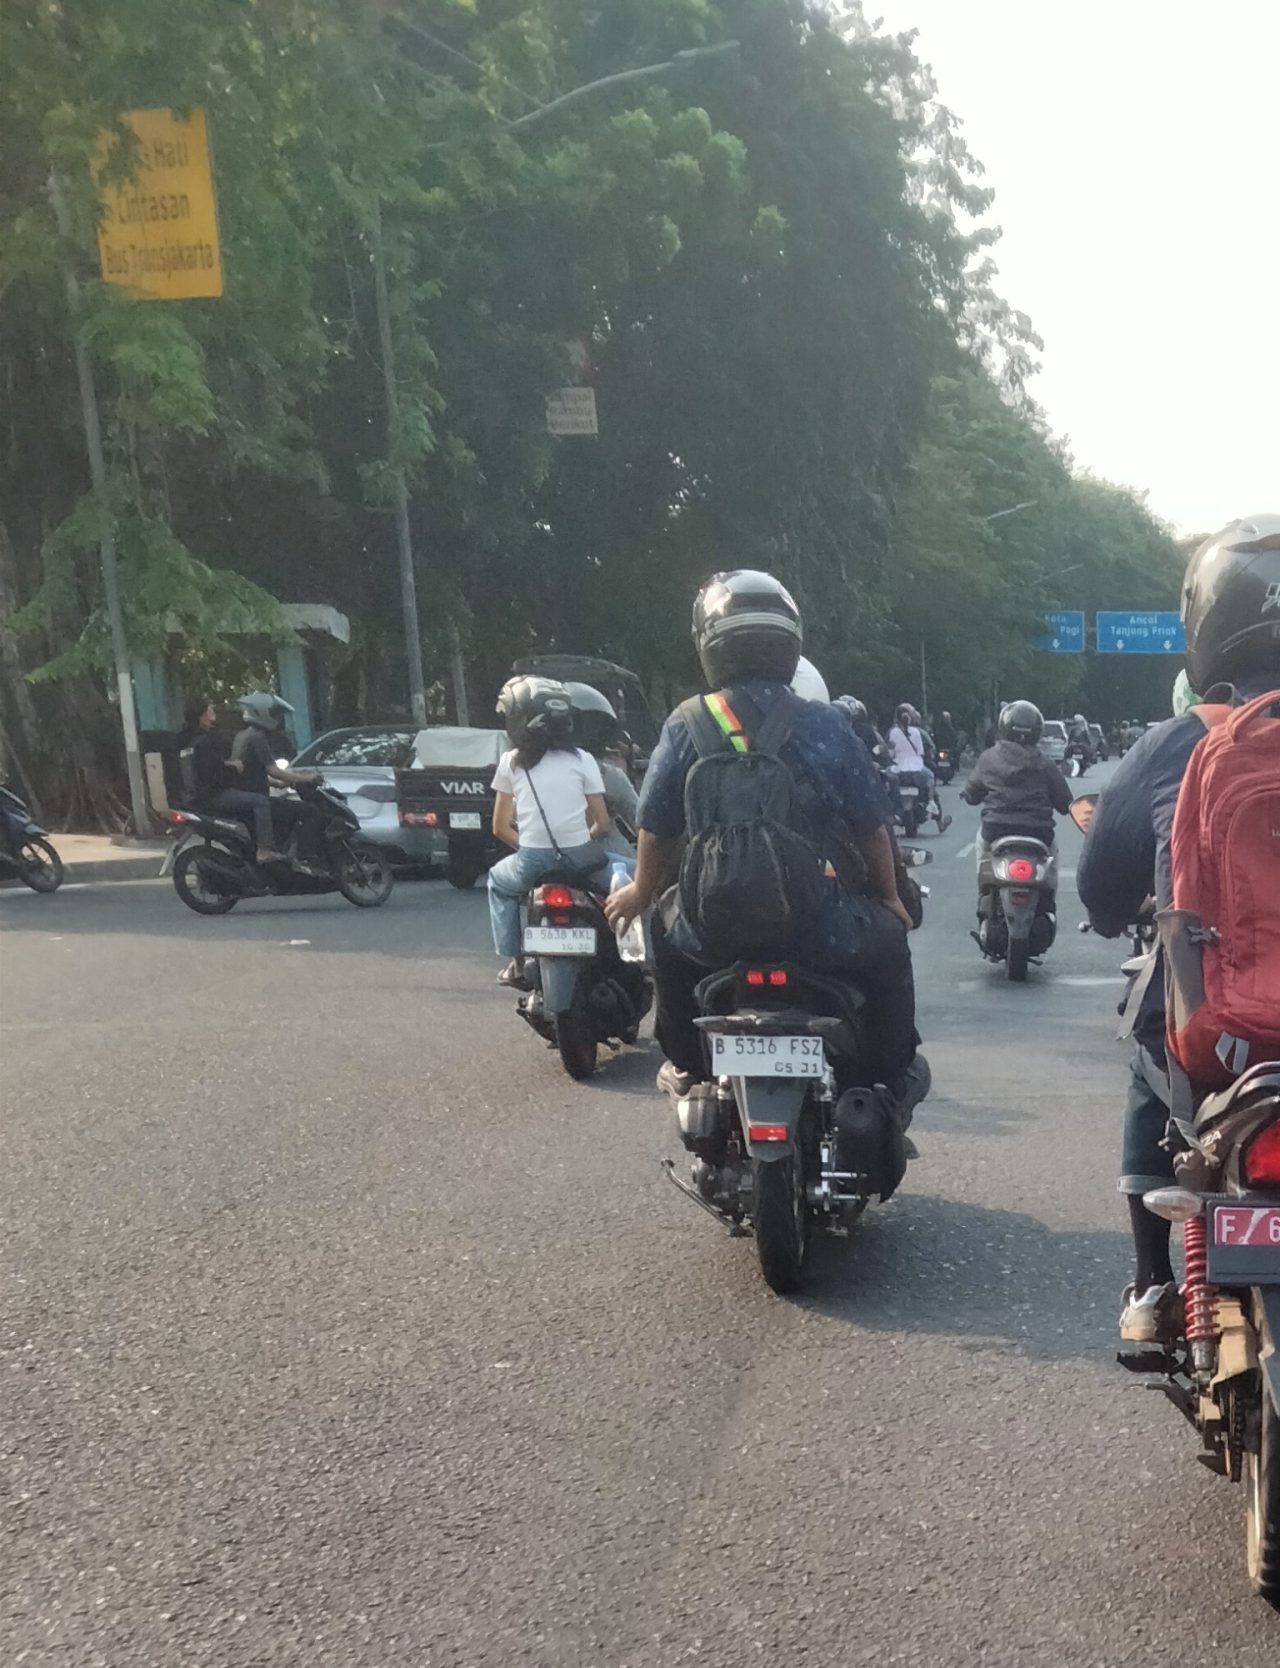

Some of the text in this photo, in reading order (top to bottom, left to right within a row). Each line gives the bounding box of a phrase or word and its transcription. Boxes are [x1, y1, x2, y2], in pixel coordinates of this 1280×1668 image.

[1129, 615, 1158, 625] Ancol
[1111, 626, 1177, 638] Tanjung Priok
[440, 781, 485, 794] VIAR
[715, 1037, 821, 1056] B 5316 FSZ
[1221, 1215, 1236, 1243] F
